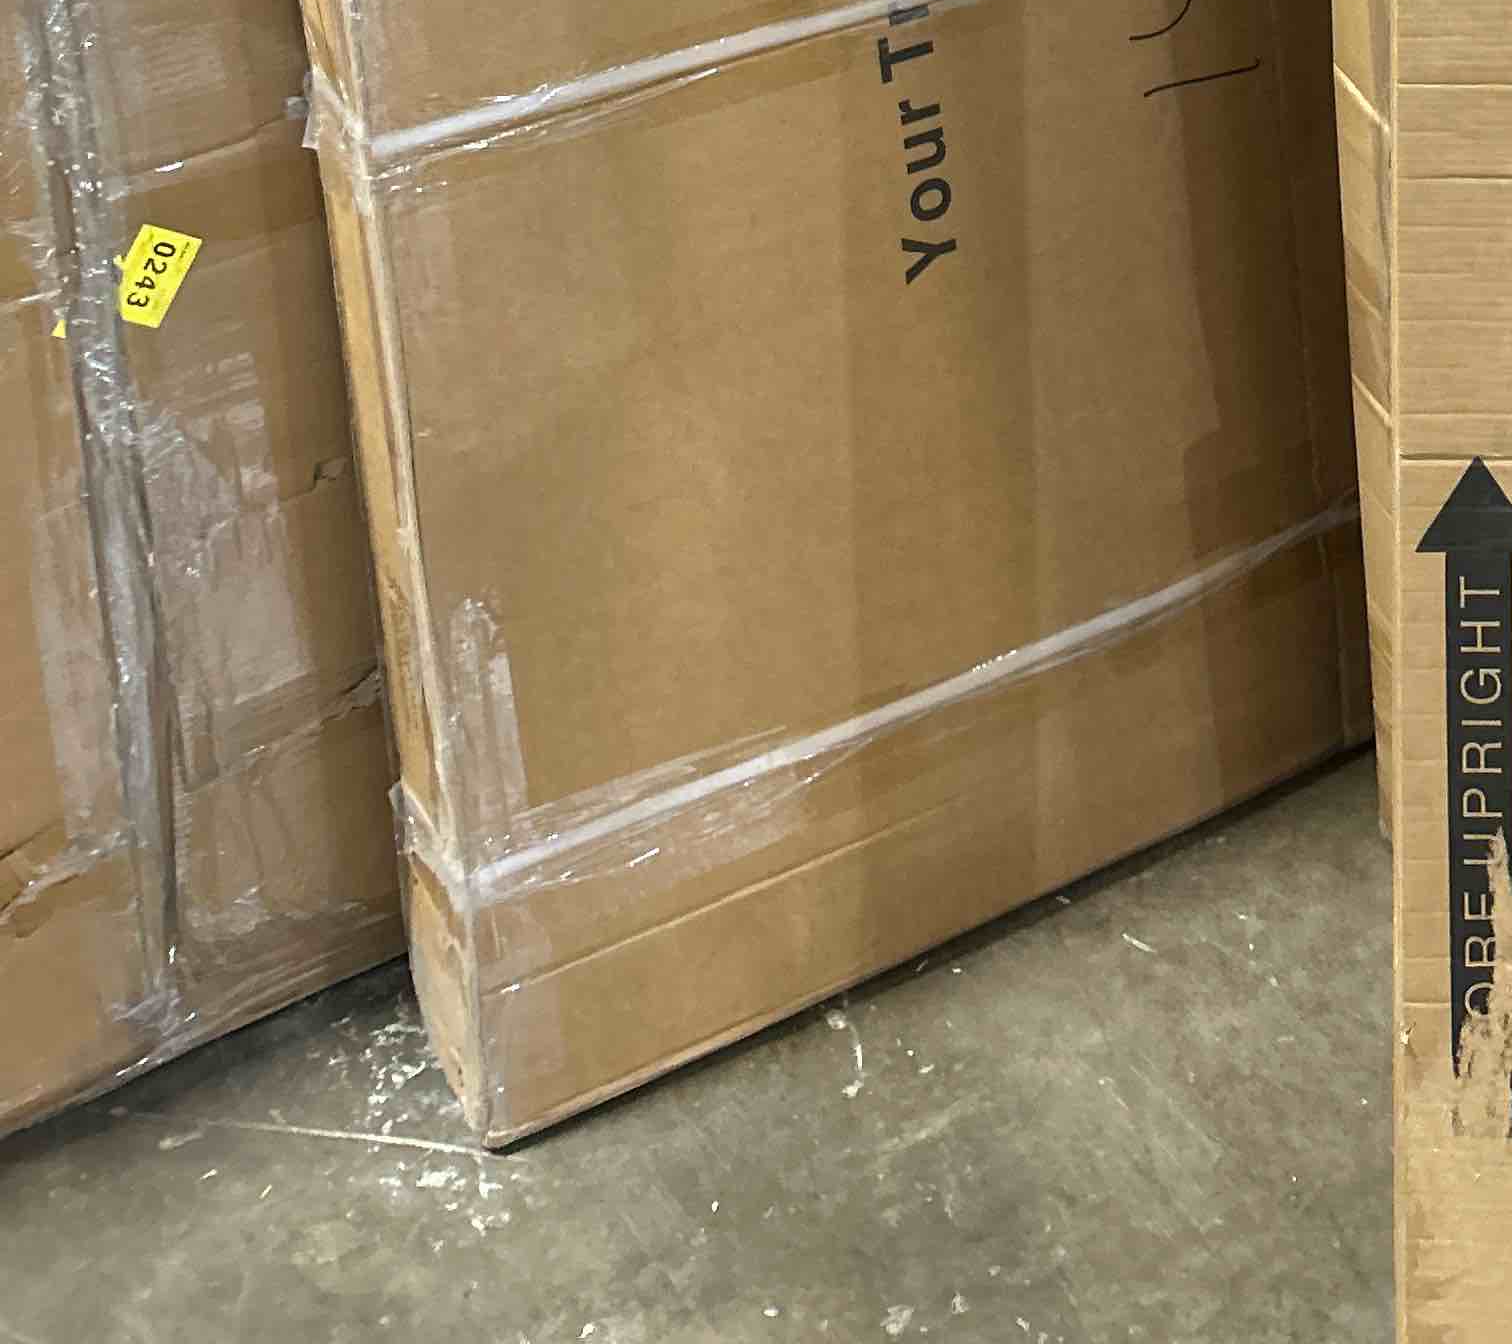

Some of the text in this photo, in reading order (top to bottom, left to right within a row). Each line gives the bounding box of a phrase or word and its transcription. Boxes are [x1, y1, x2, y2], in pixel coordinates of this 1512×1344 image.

[126, 240, 177, 308] 0243
[901, 98, 958, 285] Your
[1460, 575, 1504, 867] UPRIGHT
